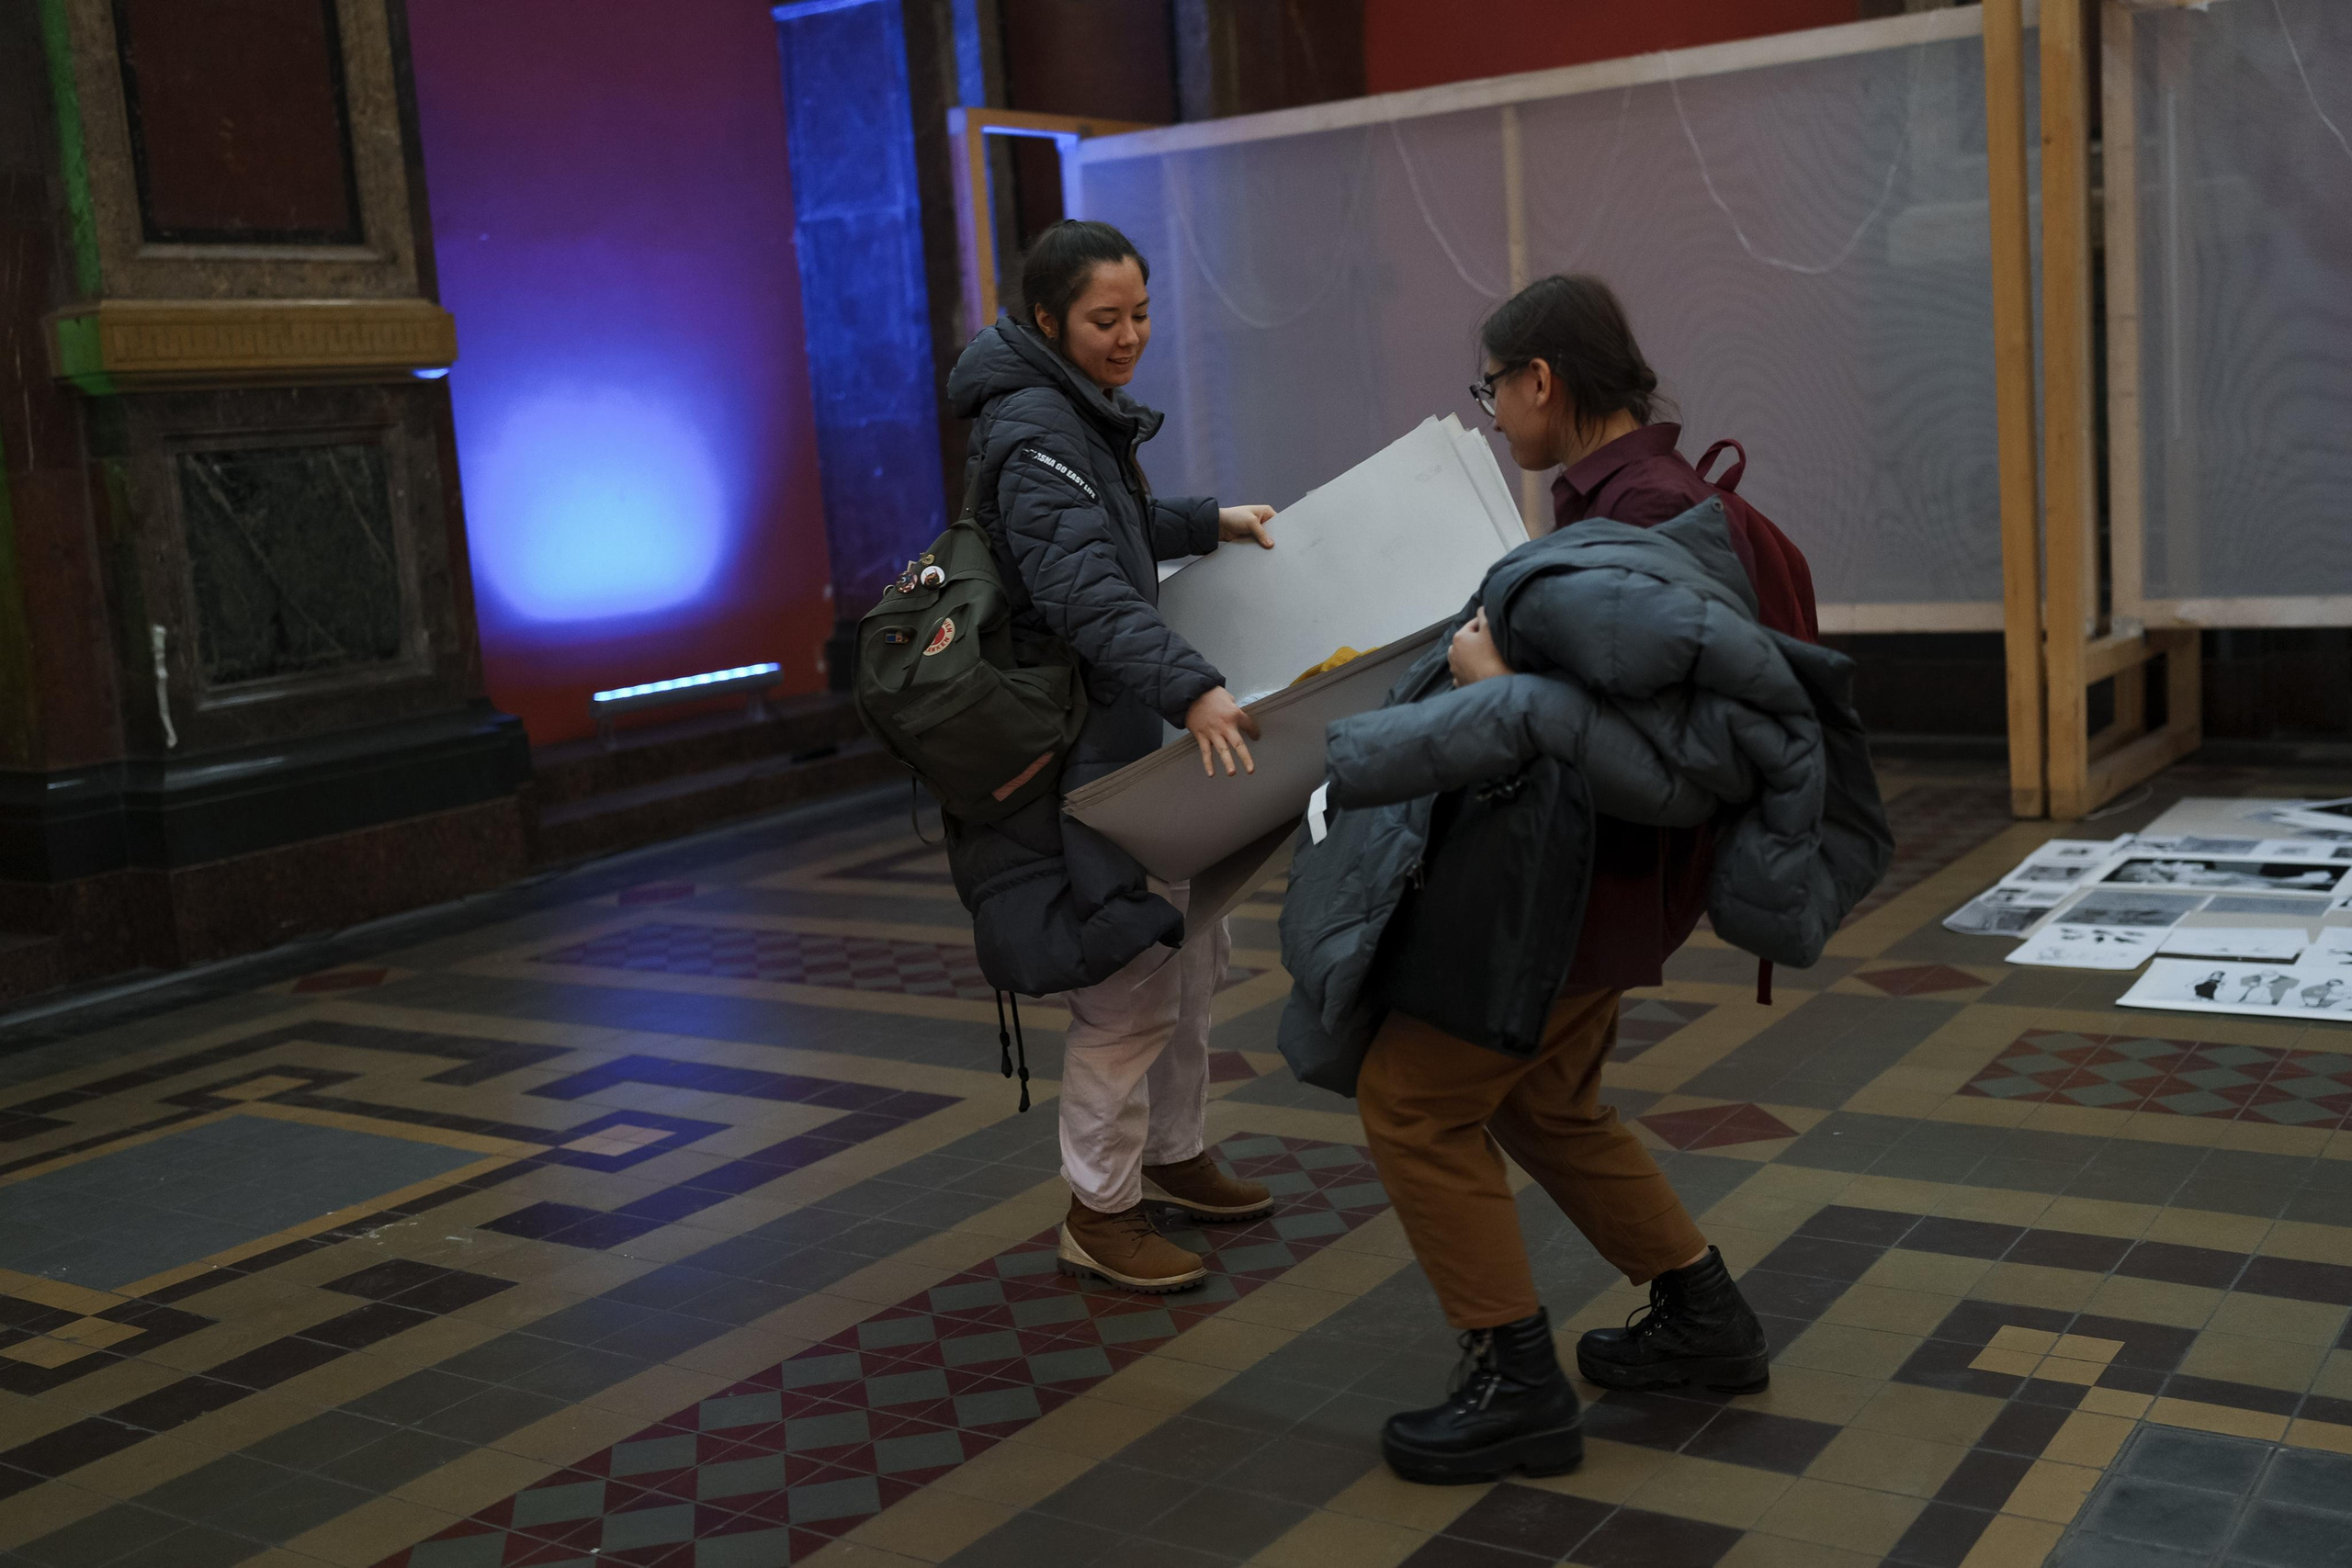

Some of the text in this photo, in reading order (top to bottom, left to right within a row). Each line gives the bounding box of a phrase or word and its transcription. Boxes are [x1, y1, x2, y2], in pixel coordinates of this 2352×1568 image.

[1055, 463, 1068, 474] GO
[1066, 469, 1085, 487] EASY
[1083, 484, 1096, 500] LIFE
